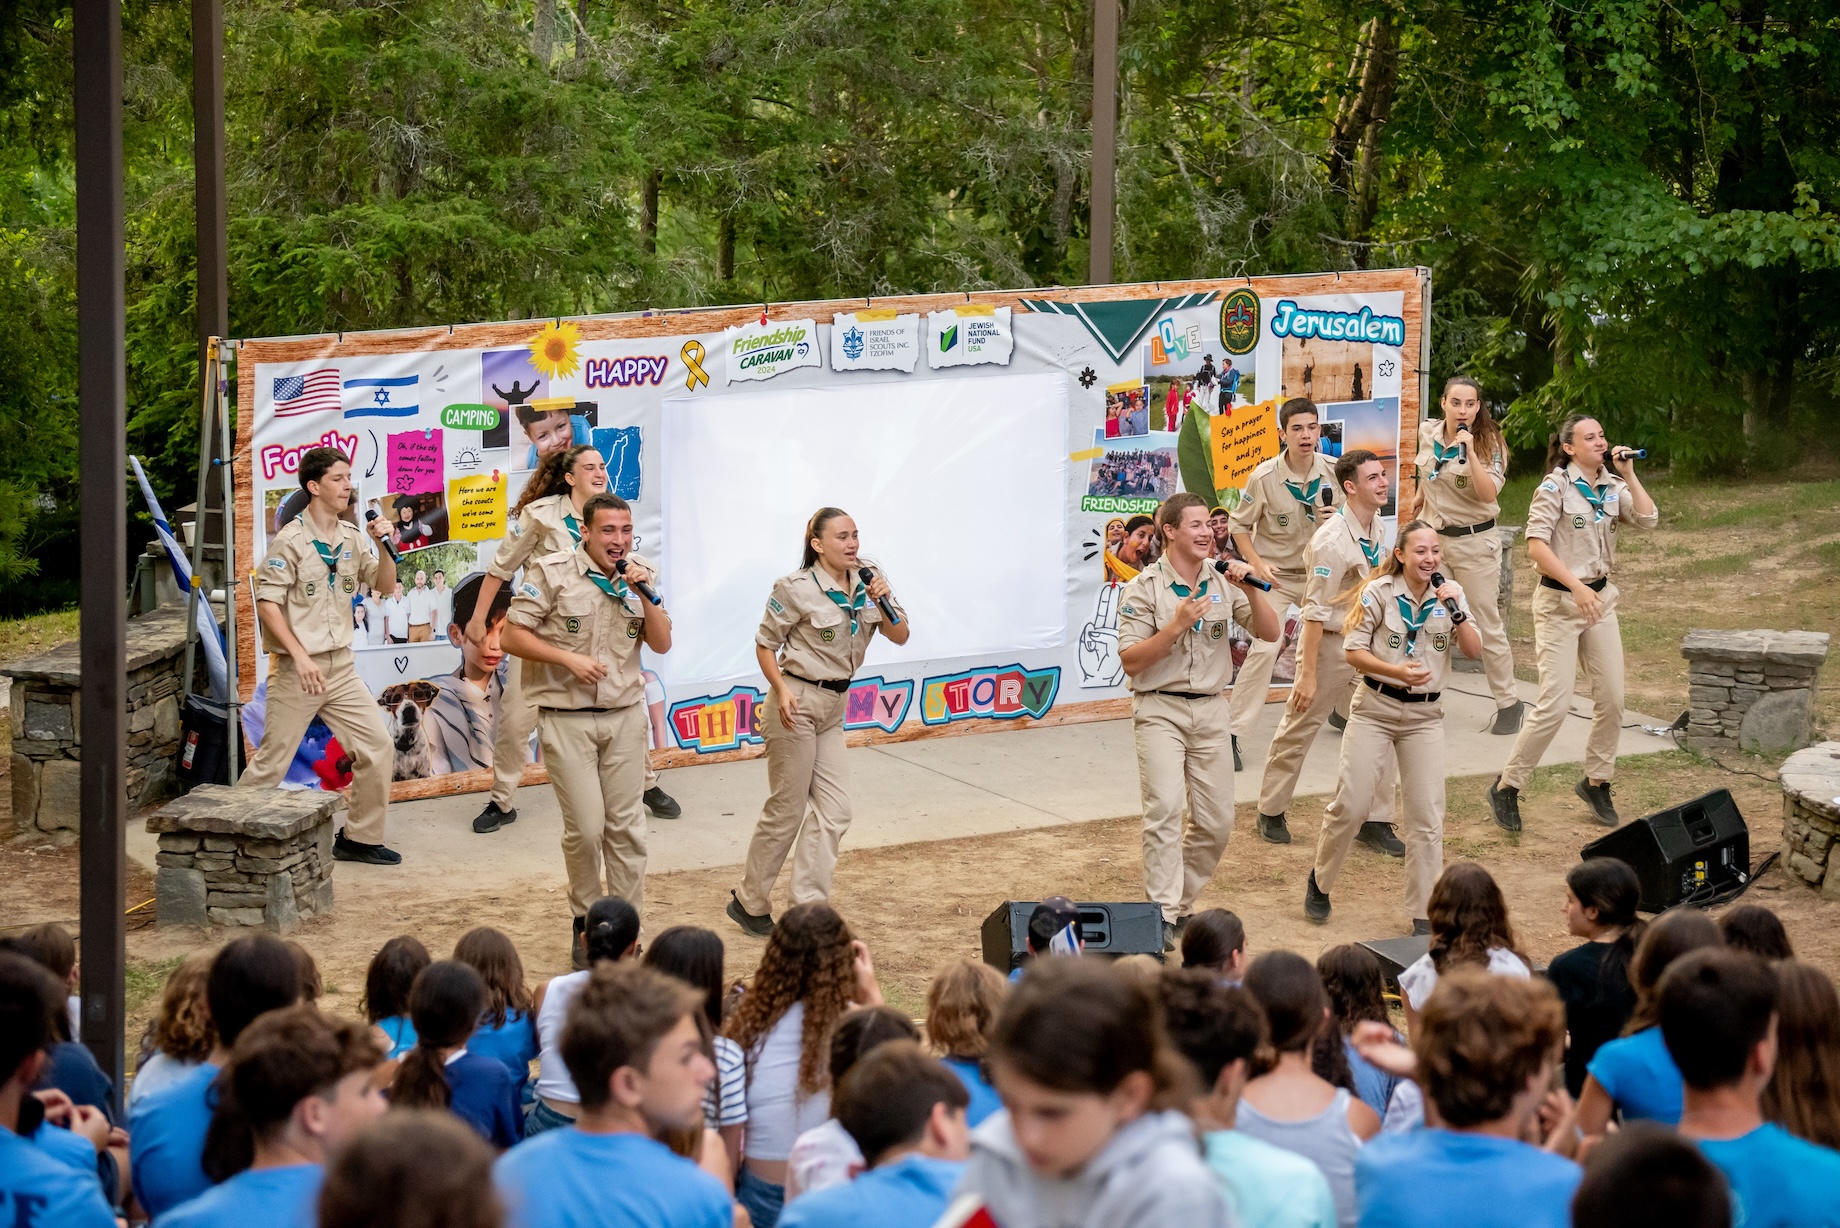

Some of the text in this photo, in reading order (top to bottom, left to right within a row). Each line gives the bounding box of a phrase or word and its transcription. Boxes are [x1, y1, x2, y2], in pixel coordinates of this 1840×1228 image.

[1273, 304, 1401, 344] Jerusalem
[732, 325, 807, 355] Friendship
[869, 328, 905, 337] FRIENDS OF
[869, 336, 890, 344] ISRAEL
[968, 329, 1000, 337] NATIONAL
[1152, 320, 1201, 364] LOVE
[740, 347, 795, 370] CARAVAN
[587, 357, 667, 386] HAPPY
[757, 366, 776, 374] 2024
[446, 409, 494, 426] CAMPING
[1221, 427, 1233, 438] Say
[1242, 414, 1263, 431] prayer
[410, 442, 416, 450] if
[416, 443, 426, 451] the
[428, 444, 438, 453] sky
[1222, 427, 1266, 453] for happiness
[262, 431, 357, 479] Faly
[417, 454, 437, 464] falling
[1236, 445, 1262, 461] and joy
[414, 465, 424, 473] for
[424, 468, 436, 476] you
[1231, 464, 1254, 480] forever
[458, 486, 473, 495] Here
[475, 497, 494, 505] scouts
[1082, 496, 1159, 513] FRIENDSHIP
[484, 521, 497, 529] you
[850, 692, 902, 719] MY
[930, 677, 1049, 714] STORY
